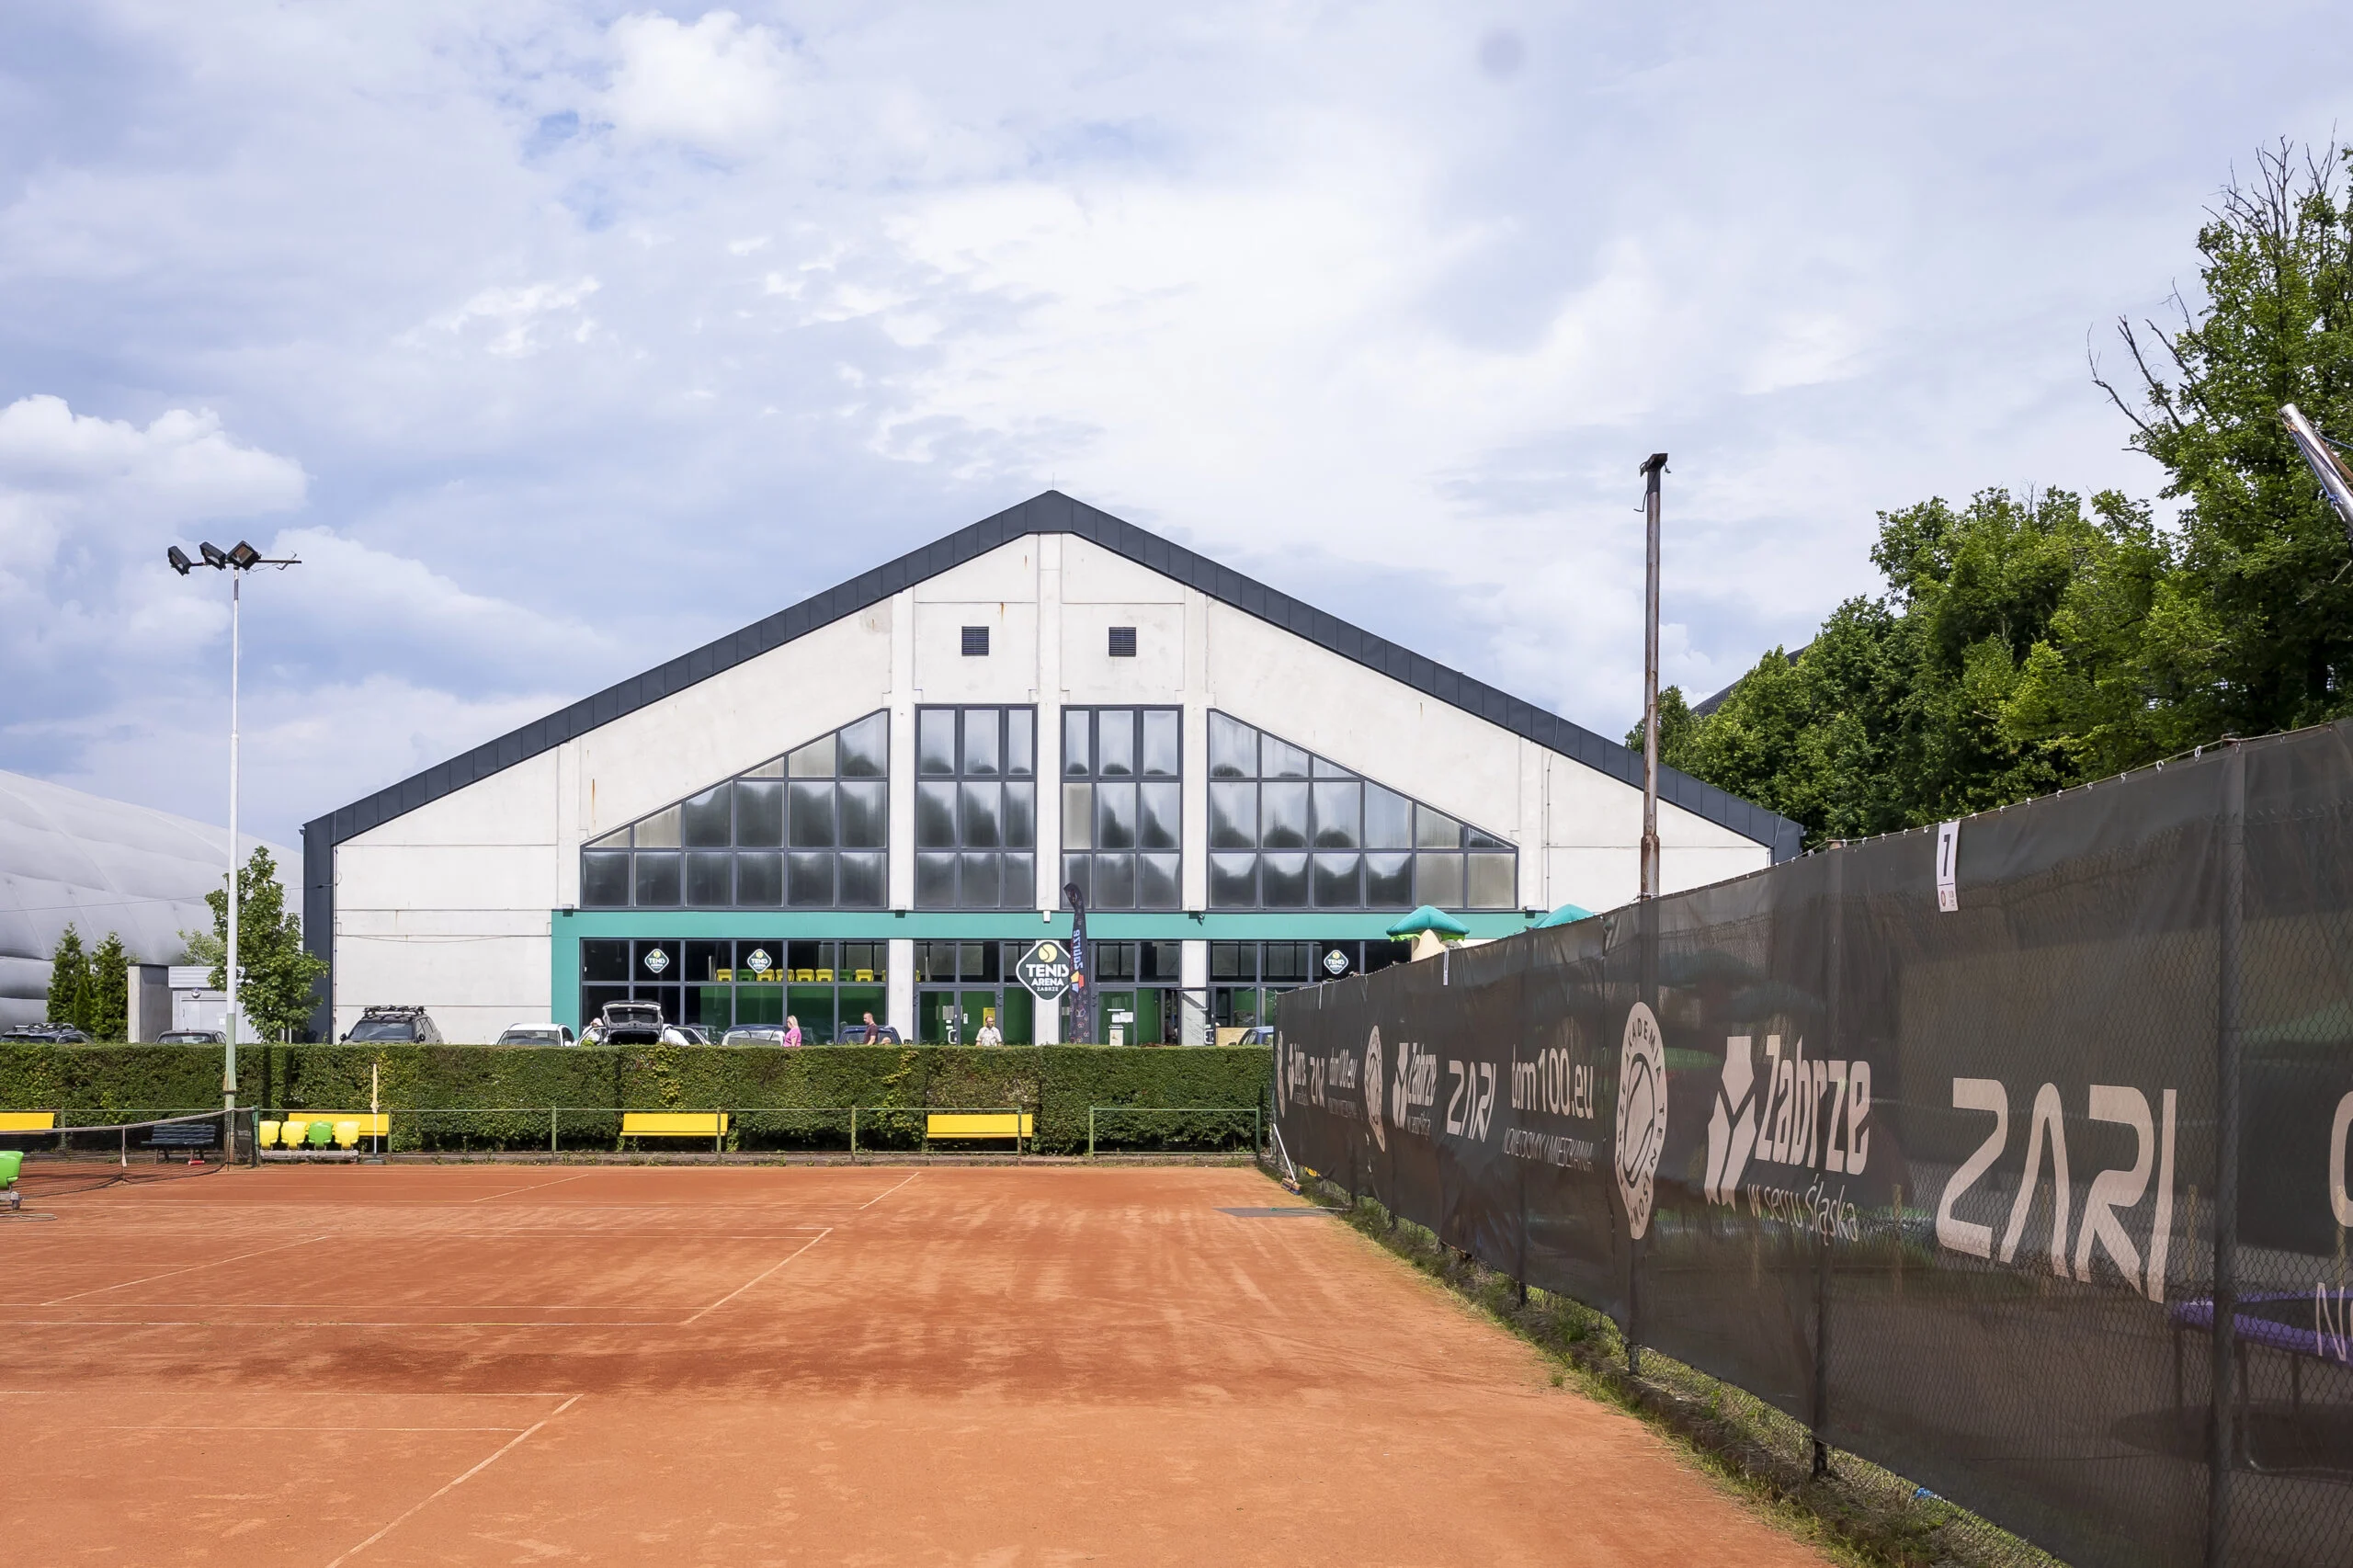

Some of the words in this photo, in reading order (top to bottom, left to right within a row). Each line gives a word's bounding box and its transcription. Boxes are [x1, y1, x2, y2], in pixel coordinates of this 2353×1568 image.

[1943, 834, 1950, 877] 1
[1025, 963, 1070, 977] TENIS
[1755, 1034, 1871, 1176] Zabrze
[1747, 1183, 1761, 1218] w
[1936, 1077, 2177, 1304] ZARI
